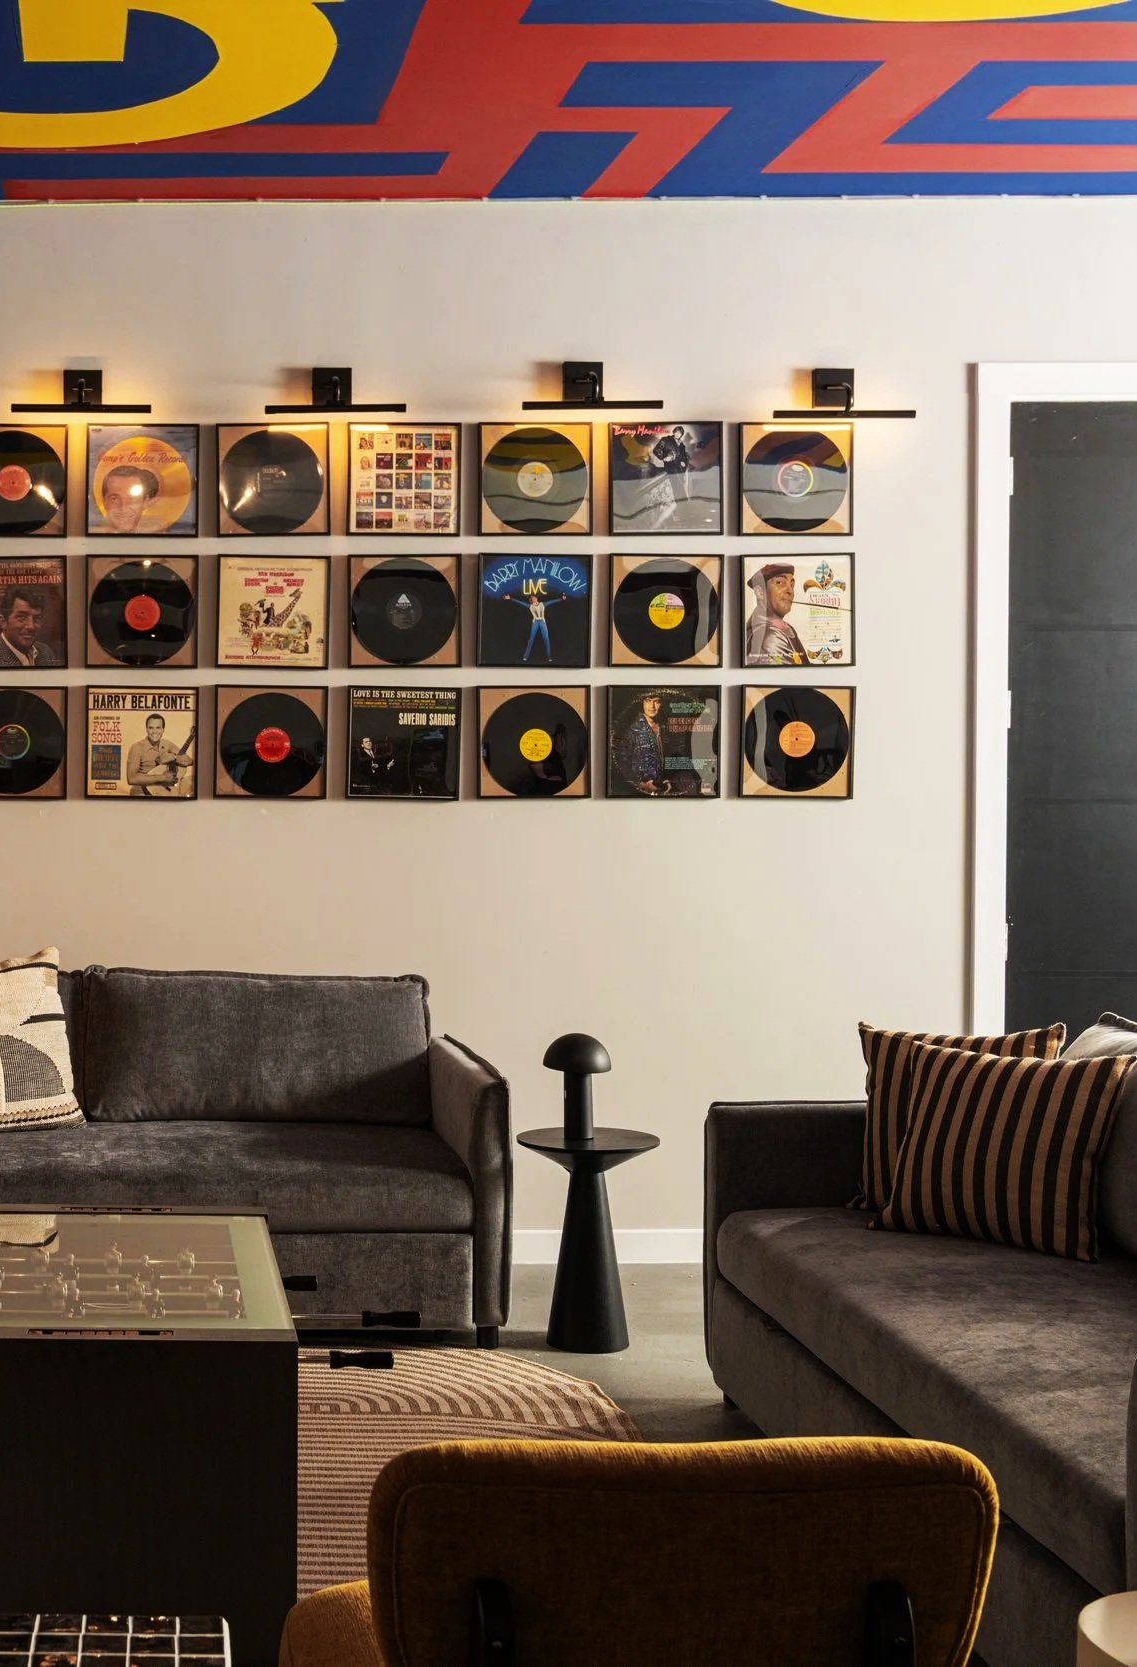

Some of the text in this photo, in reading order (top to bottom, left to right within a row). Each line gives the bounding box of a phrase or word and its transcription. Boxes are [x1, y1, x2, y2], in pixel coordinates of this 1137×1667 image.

[18, 575, 37, 584] HITS
[38, 575, 62, 584] AGAIN
[484, 558, 587, 592] BARRY MANILOW
[523, 579, 547, 594] LIVE
[353, 690, 456, 699] LOVE IS THE SWEETEST THING
[93, 695, 191, 709] HARRY BELAFONTE
[398, 712, 456, 726] SAVERIO SARIDIS
[93, 721, 120, 732] FOLK
[91, 732, 122, 743] SONGS
